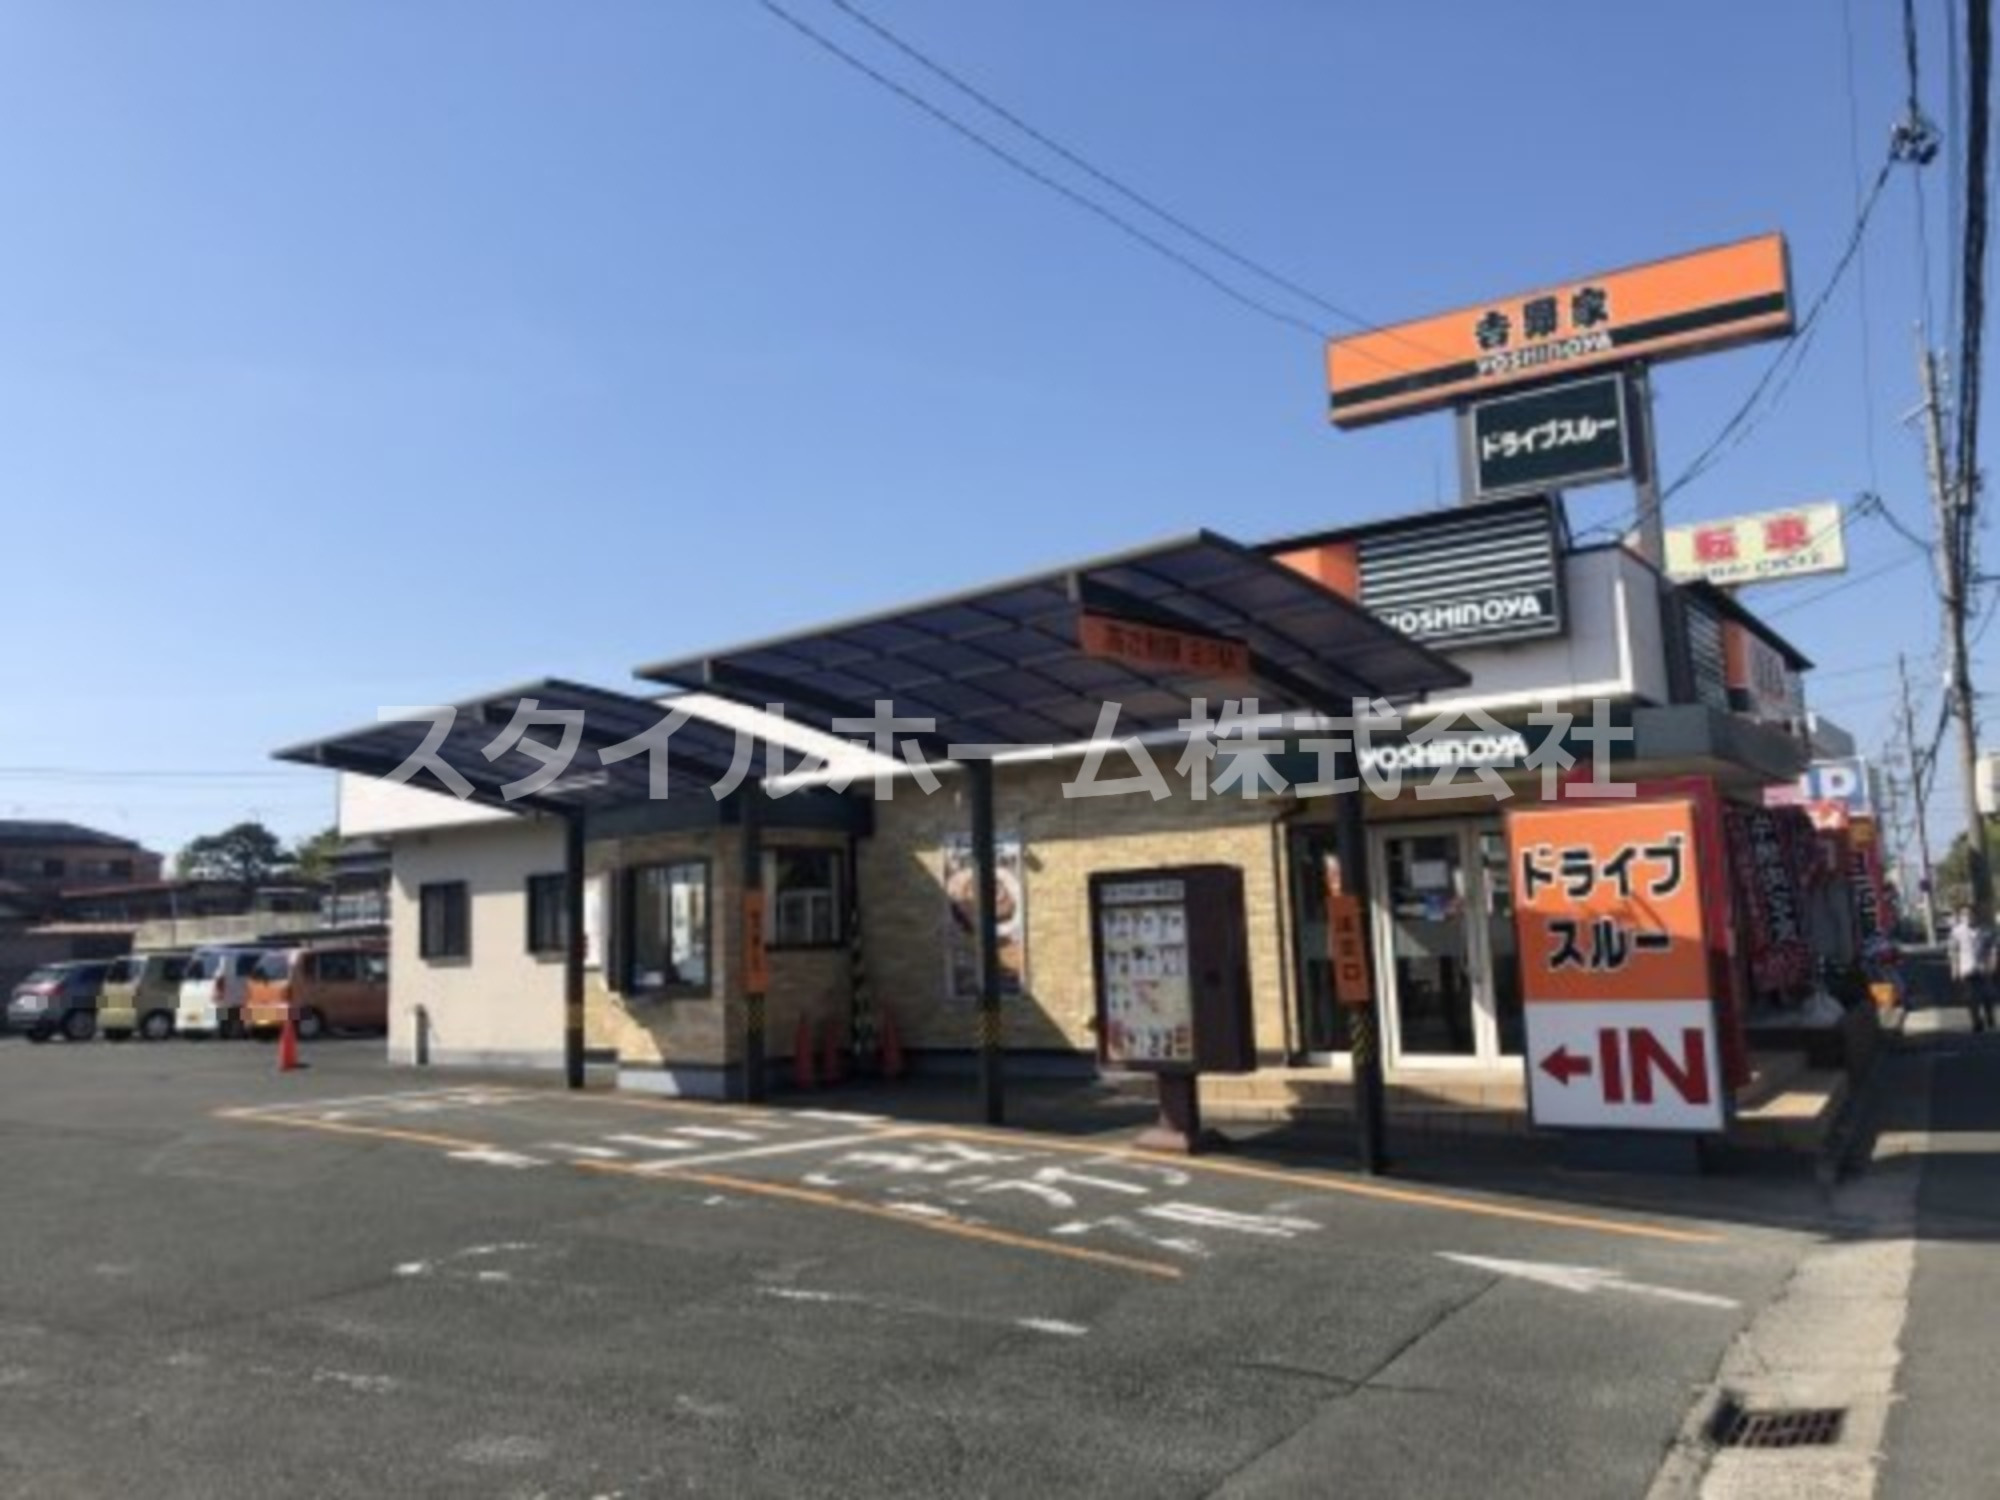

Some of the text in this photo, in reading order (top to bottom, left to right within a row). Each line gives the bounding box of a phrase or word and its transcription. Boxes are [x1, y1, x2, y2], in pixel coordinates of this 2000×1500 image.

[1476, 287, 1609, 349] 吉野家
[1483, 415, 1617, 461] ドライブスルー
[1360, 734, 1528, 772] YOSHINOYA
[1523, 835, 1684, 900] ドライブ
[1549, 917, 1672, 970] スルー
[1598, 1027, 1709, 1105] IN
